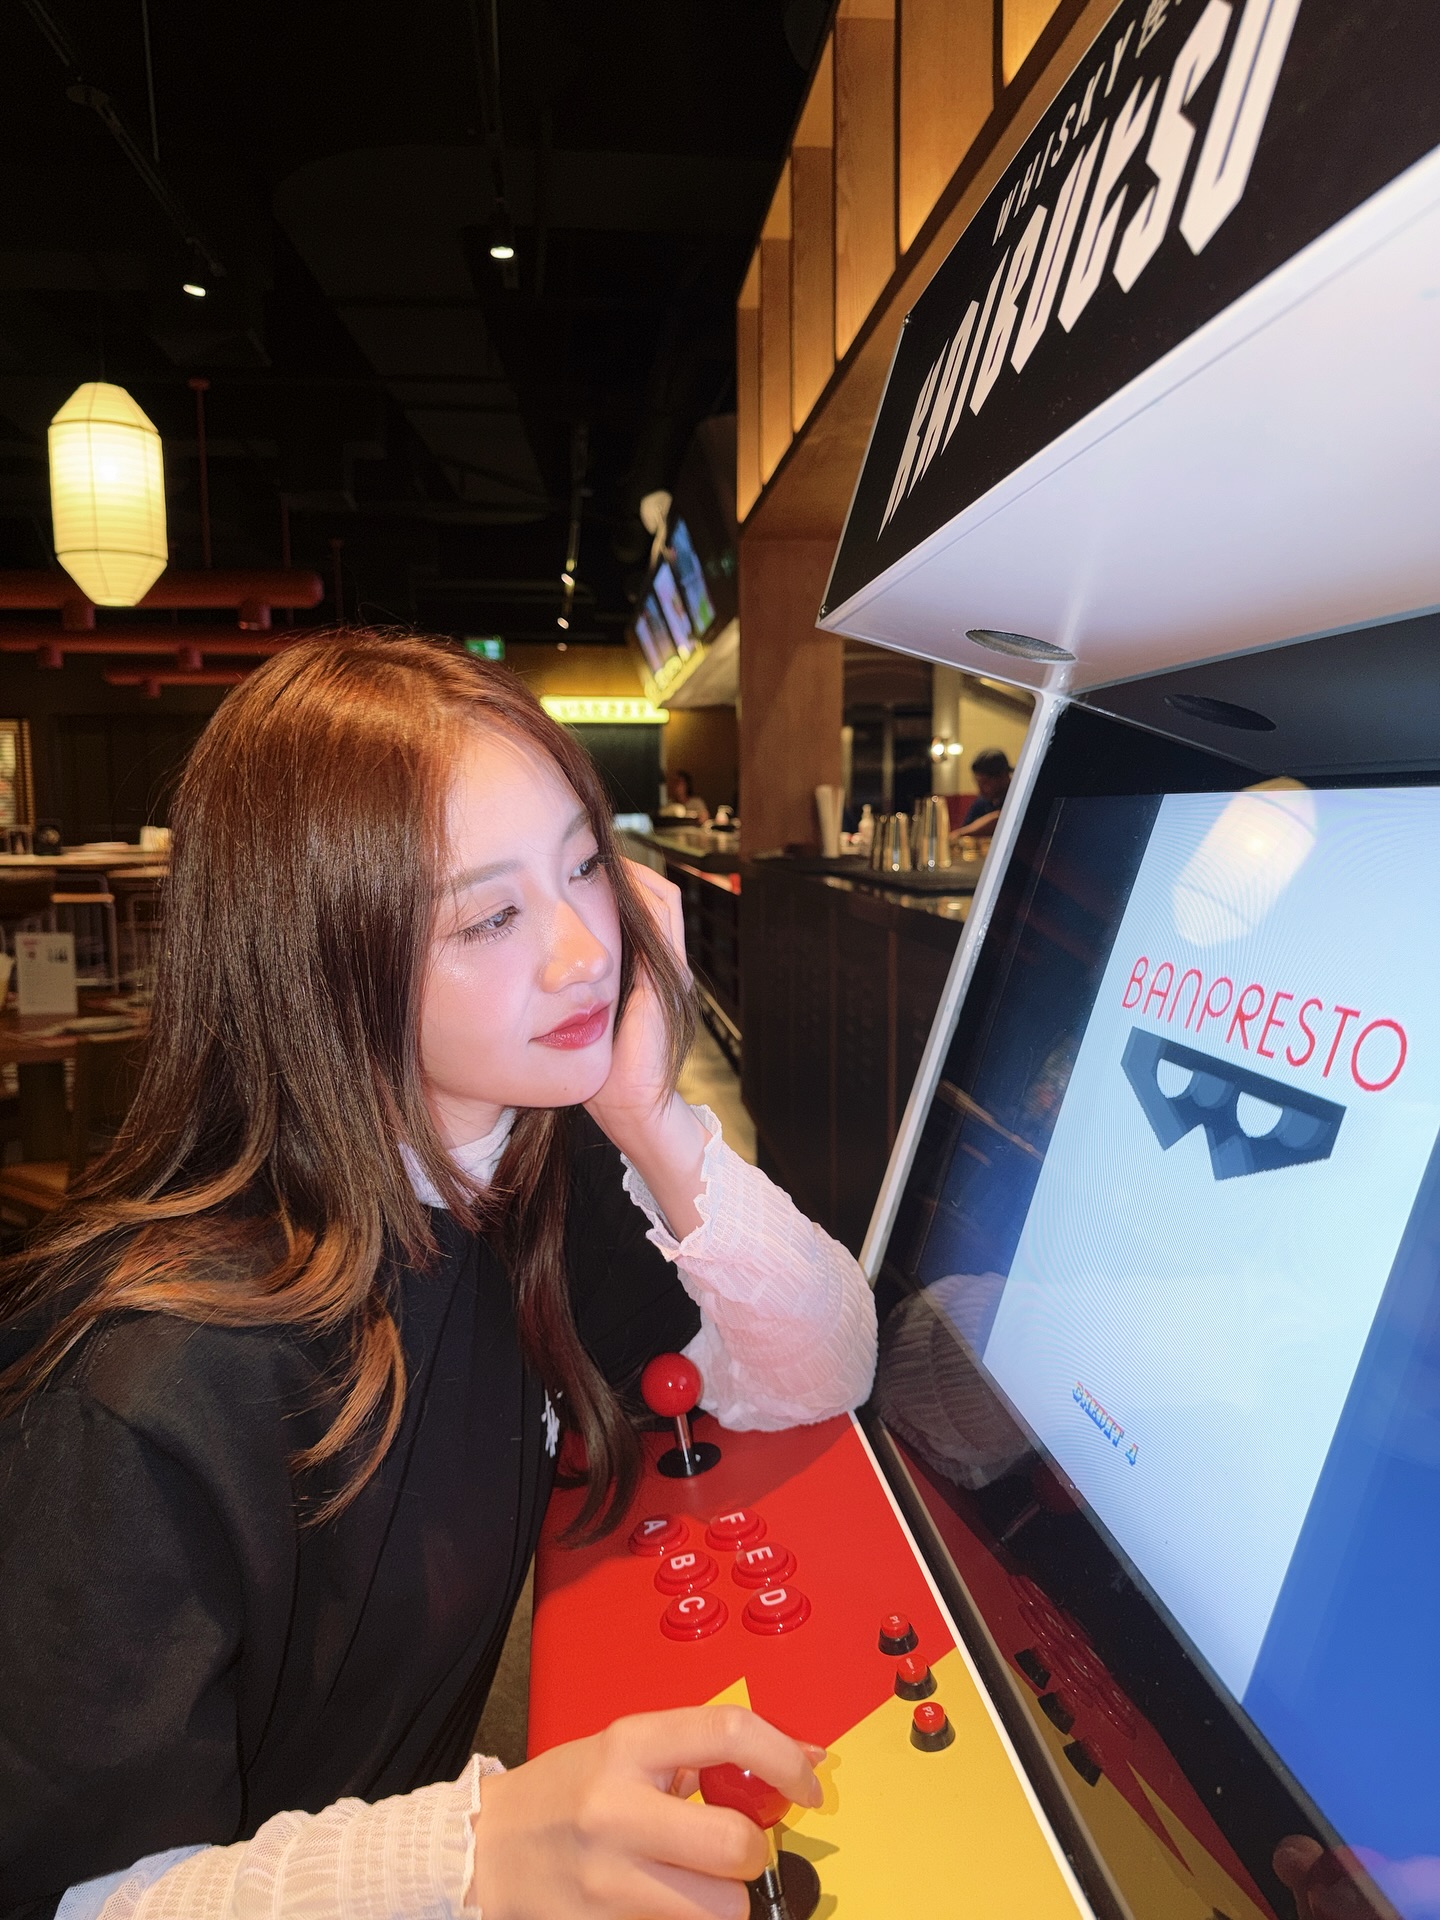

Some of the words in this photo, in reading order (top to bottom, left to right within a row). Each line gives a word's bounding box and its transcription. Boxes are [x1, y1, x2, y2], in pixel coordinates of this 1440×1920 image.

[992, 19, 1136, 247] WHISKY
[1121, 956, 1408, 1092] BANPRESTO
[1072, 1381, 1125, 1448] CREDIT
[719, 1511, 746, 1524] F
[643, 1519, 668, 1535] A
[670, 1553, 696, 1570] B
[746, 1546, 774, 1565] E
[678, 1596, 706, 1614] C
[759, 1588, 787, 1606] D
[889, 1615, 900, 1625] P1
[922, 1705, 935, 1717] P2
